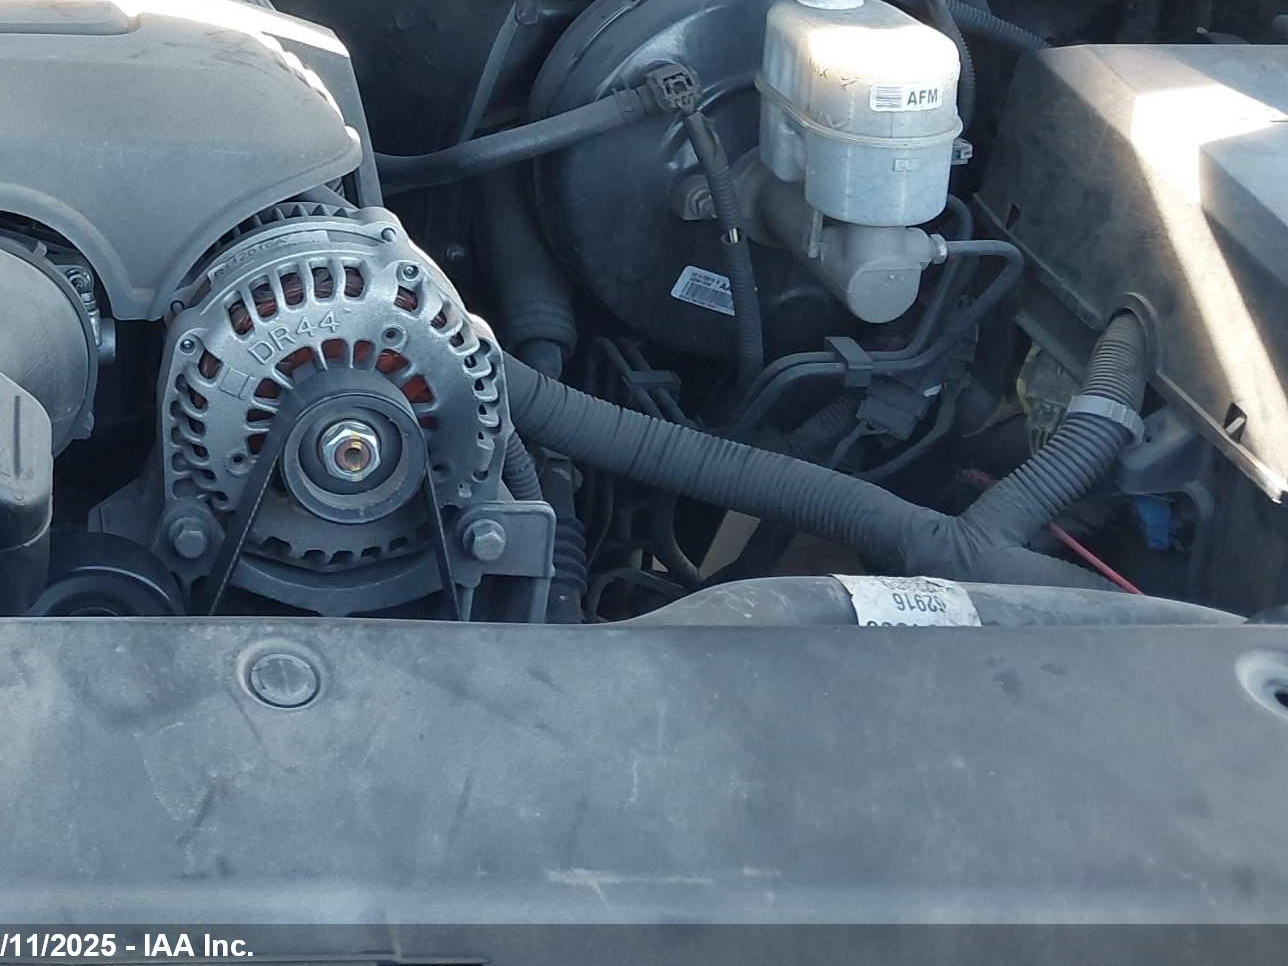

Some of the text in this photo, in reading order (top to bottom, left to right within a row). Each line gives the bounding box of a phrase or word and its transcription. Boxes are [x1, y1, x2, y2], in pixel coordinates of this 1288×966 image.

[907, 88, 939, 106] AFM
[247, 309, 341, 365] DR44
[893, 592, 947, 613] 62916
